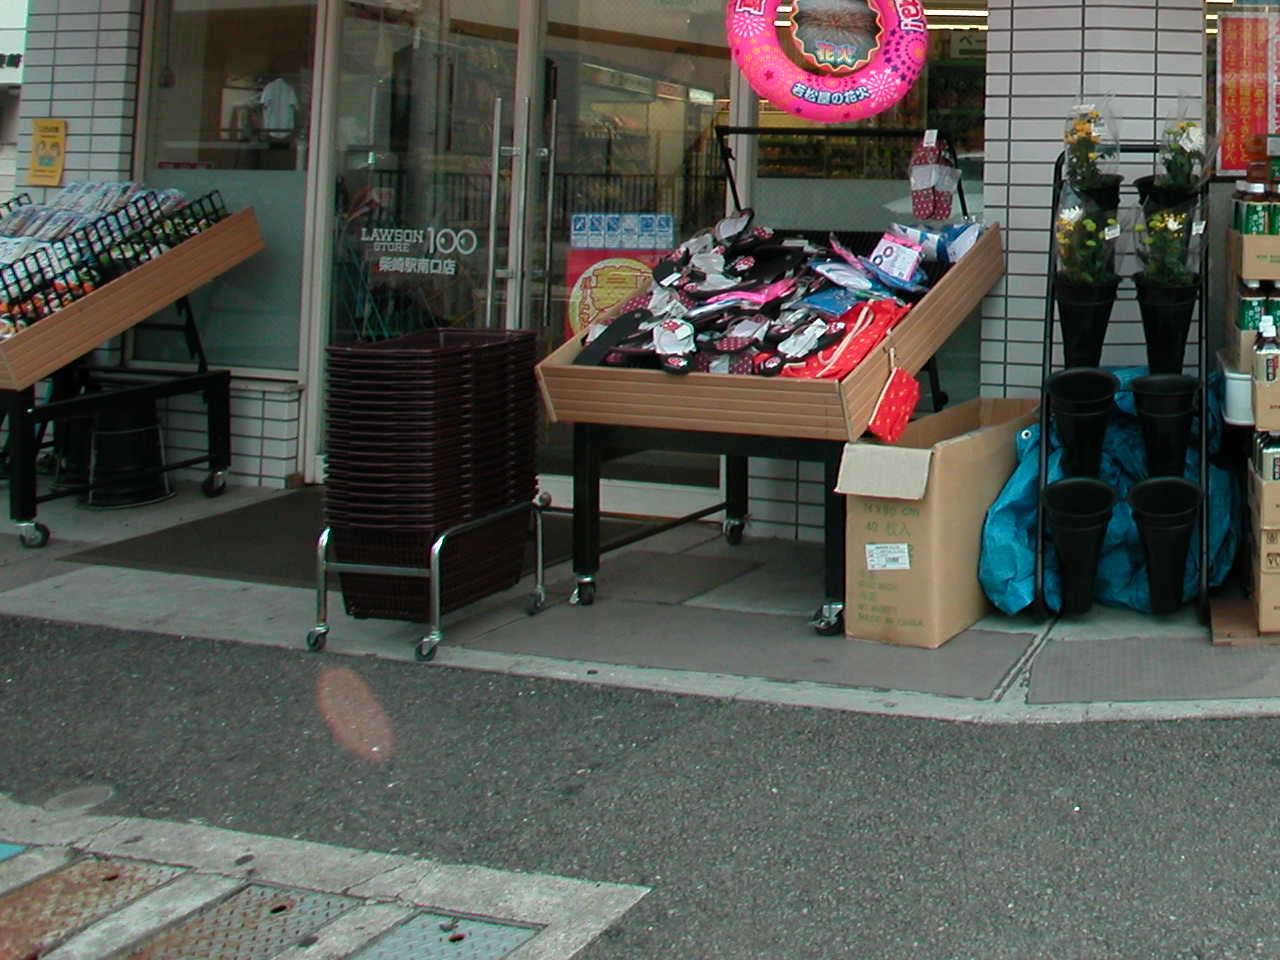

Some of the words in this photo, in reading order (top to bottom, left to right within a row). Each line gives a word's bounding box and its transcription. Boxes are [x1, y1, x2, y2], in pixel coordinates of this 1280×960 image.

[361, 227, 424, 243] LAWSON
[427, 226, 478, 255] 100
[373, 242, 410, 253] STORE
